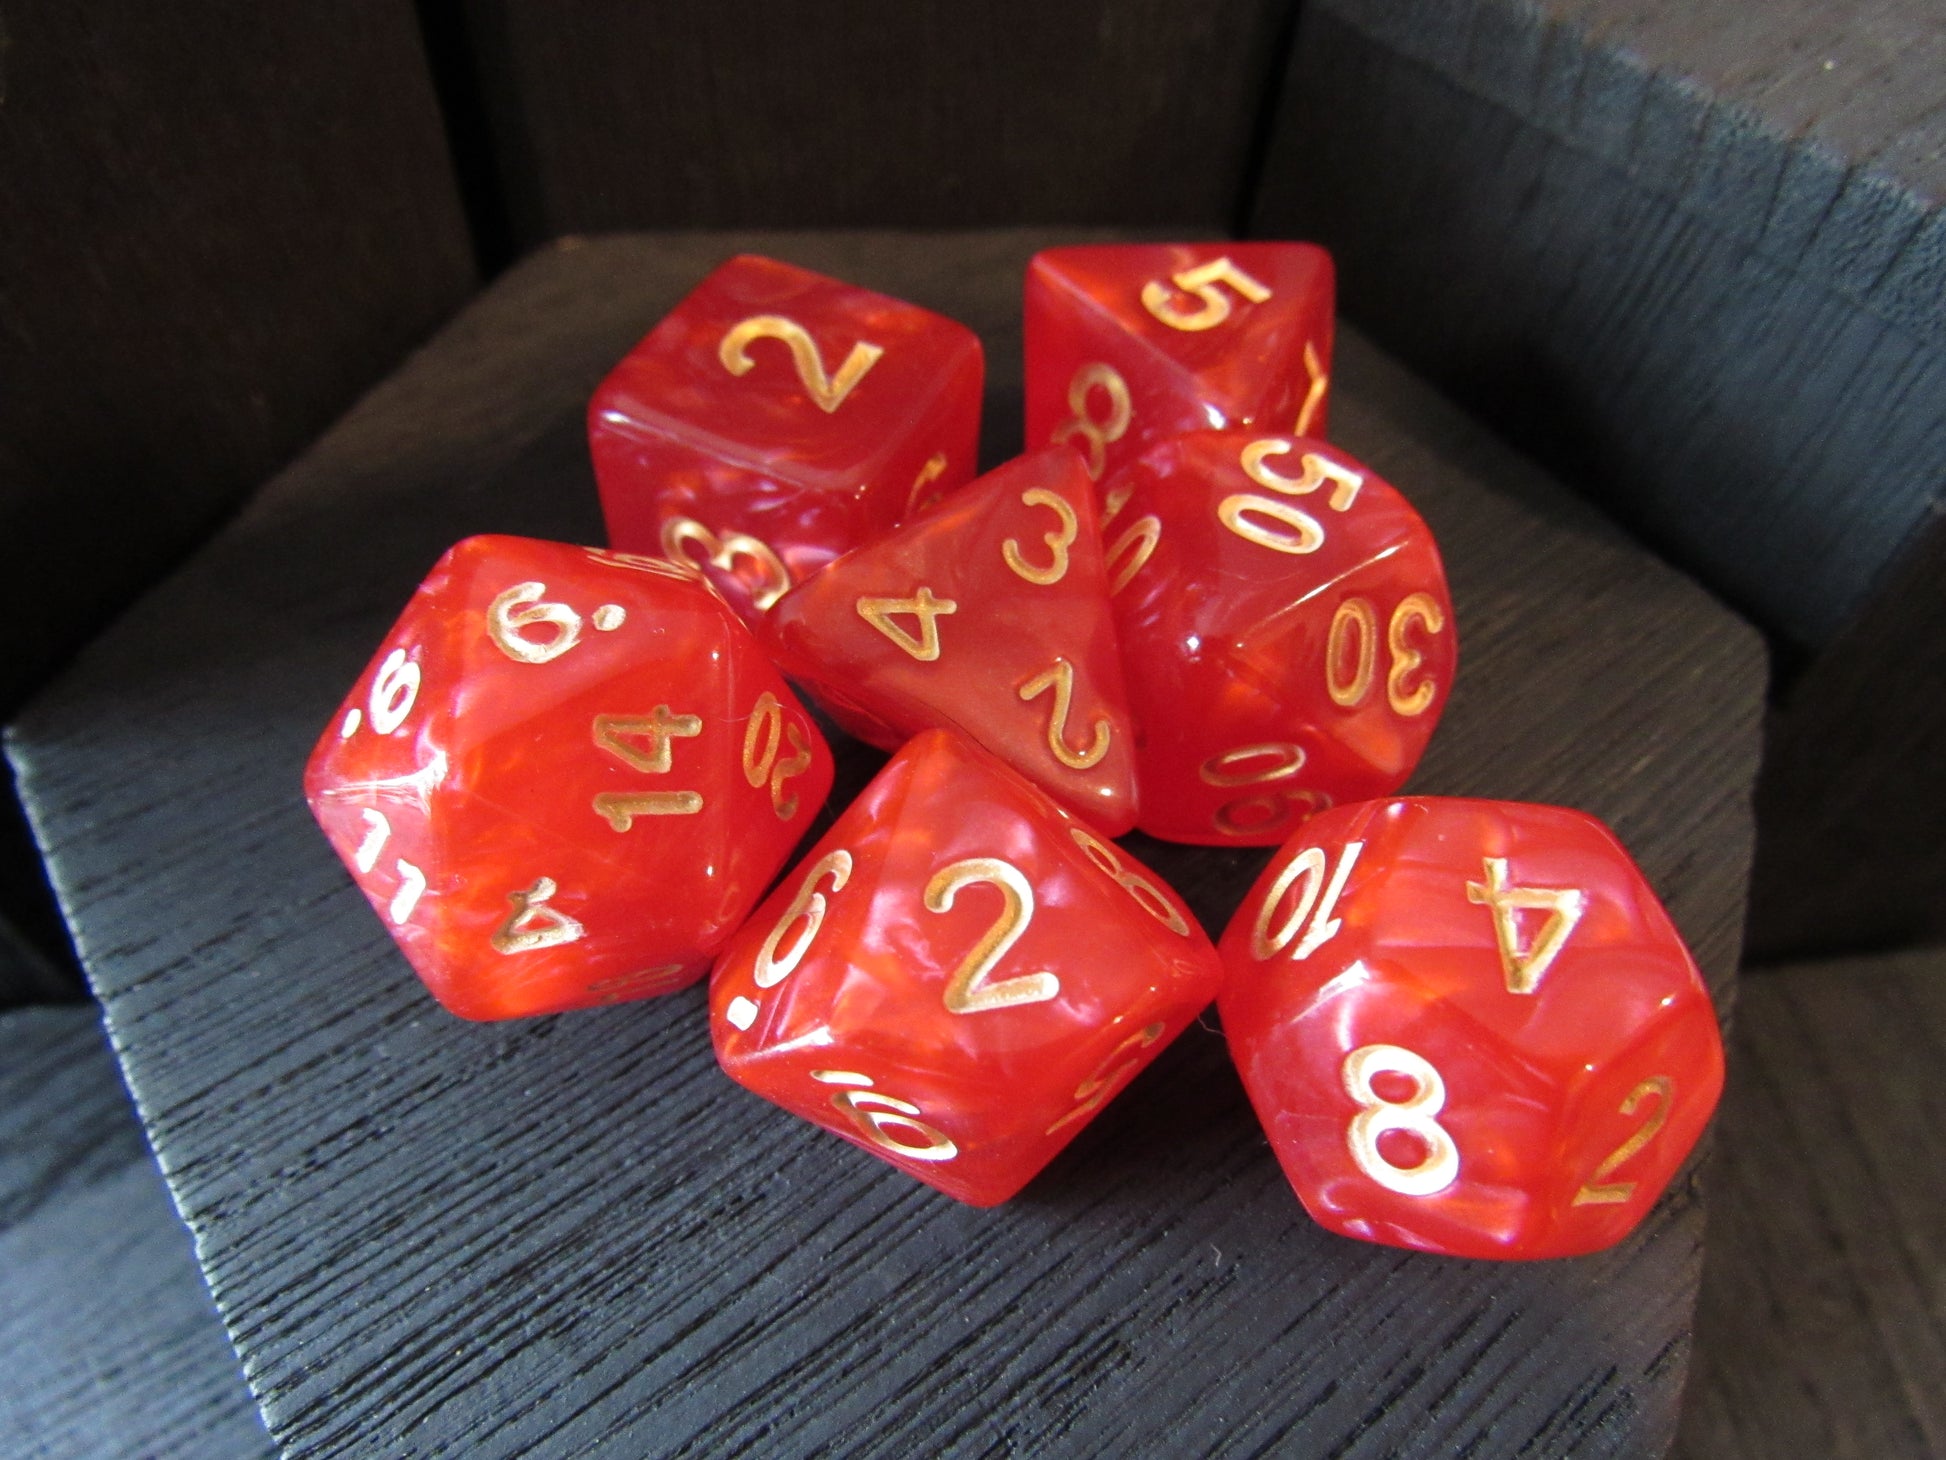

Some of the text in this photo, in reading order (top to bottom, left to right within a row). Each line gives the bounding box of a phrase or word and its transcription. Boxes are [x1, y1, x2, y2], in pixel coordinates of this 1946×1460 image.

[1141, 258, 1272, 331] 5
[719, 315, 885, 413] 2
[1002, 488, 1077, 585] 3
[1218, 440, 1364, 554] 50
[856, 587, 957, 661] 4
[1326, 593, 1443, 717] 30
[592, 704, 704, 833] 14
[1019, 657, 1111, 769] 2
[490, 876, 585, 956] 4
[923, 857, 1060, 1015] 2
[1070, 827, 1190, 937] 8
[1252, 841, 1364, 961] 10
[1466, 856, 1584, 994] 4
[1343, 1044, 1460, 1196] 8
[1571, 1075, 1673, 1207] 2
